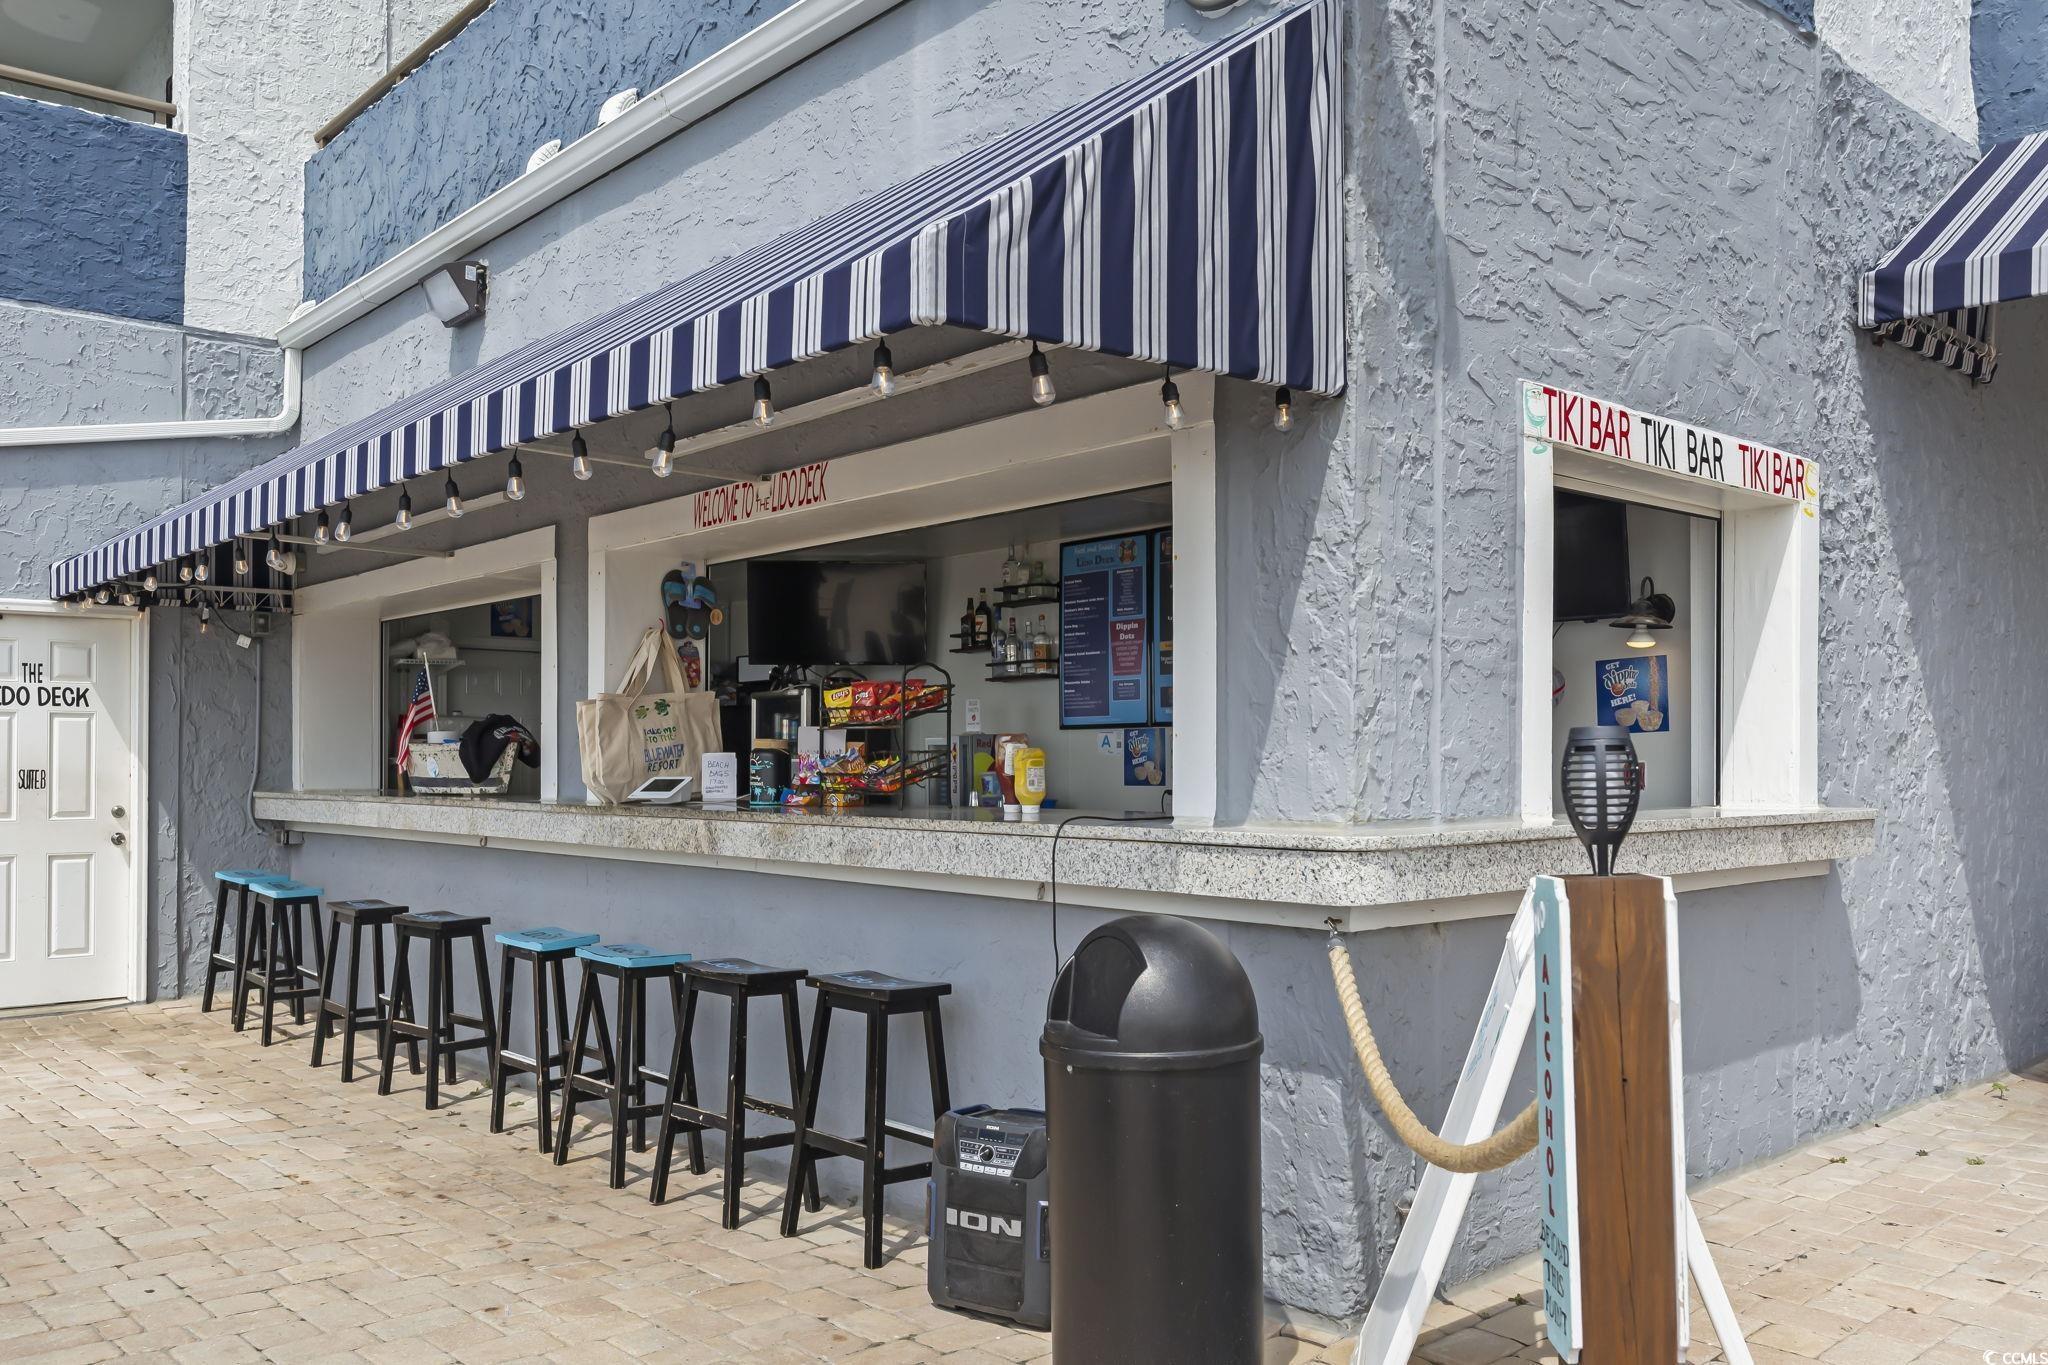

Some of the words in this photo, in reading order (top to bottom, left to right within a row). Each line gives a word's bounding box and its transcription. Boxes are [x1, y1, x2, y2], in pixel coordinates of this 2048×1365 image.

[1543, 386, 1584, 446] TIKI
[1590, 402, 1632, 459] BAR
[1641, 417, 1676, 470] TIKI
[1687, 429, 1725, 482] BAR
[1738, 443, 1769, 492] TIKI
[1773, 453, 1806, 500] BAR
[693, 484, 738, 529] WELCOME
[738, 482, 754, 518] TO
[755, 497, 770, 513] THE
[771, 469, 797, 513] LIDO
[797, 461, 829, 508] DECK
[1116, 622, 1139, 631] Dippin
[1119, 632, 1135, 640] Dots
[22, 662, 43, 684] THE
[1606, 661, 1620, 670] GET
[0, 686, 30, 707] DO
[38, 686, 90, 708] DECK
[1610, 693, 1637, 707] HERE!
[976, 738, 992, 748] Red
[1101, 734, 1111, 748] A
[644, 743, 685, 763] BLUEWATER
[647, 759, 680, 773] RESORT
[707, 760, 730, 769] BEACH
[18, 769, 41, 790] SUITE
[40, 769, 46, 790] B
[1541, 954, 1556, 1217] ALCOHOL
[946, 1207, 1022, 1237] ION
[1540, 1218, 1570, 1268] BEYOND
[1543, 1258, 1565, 1298] THIS
[1545, 1289, 1568, 1337] POINT
